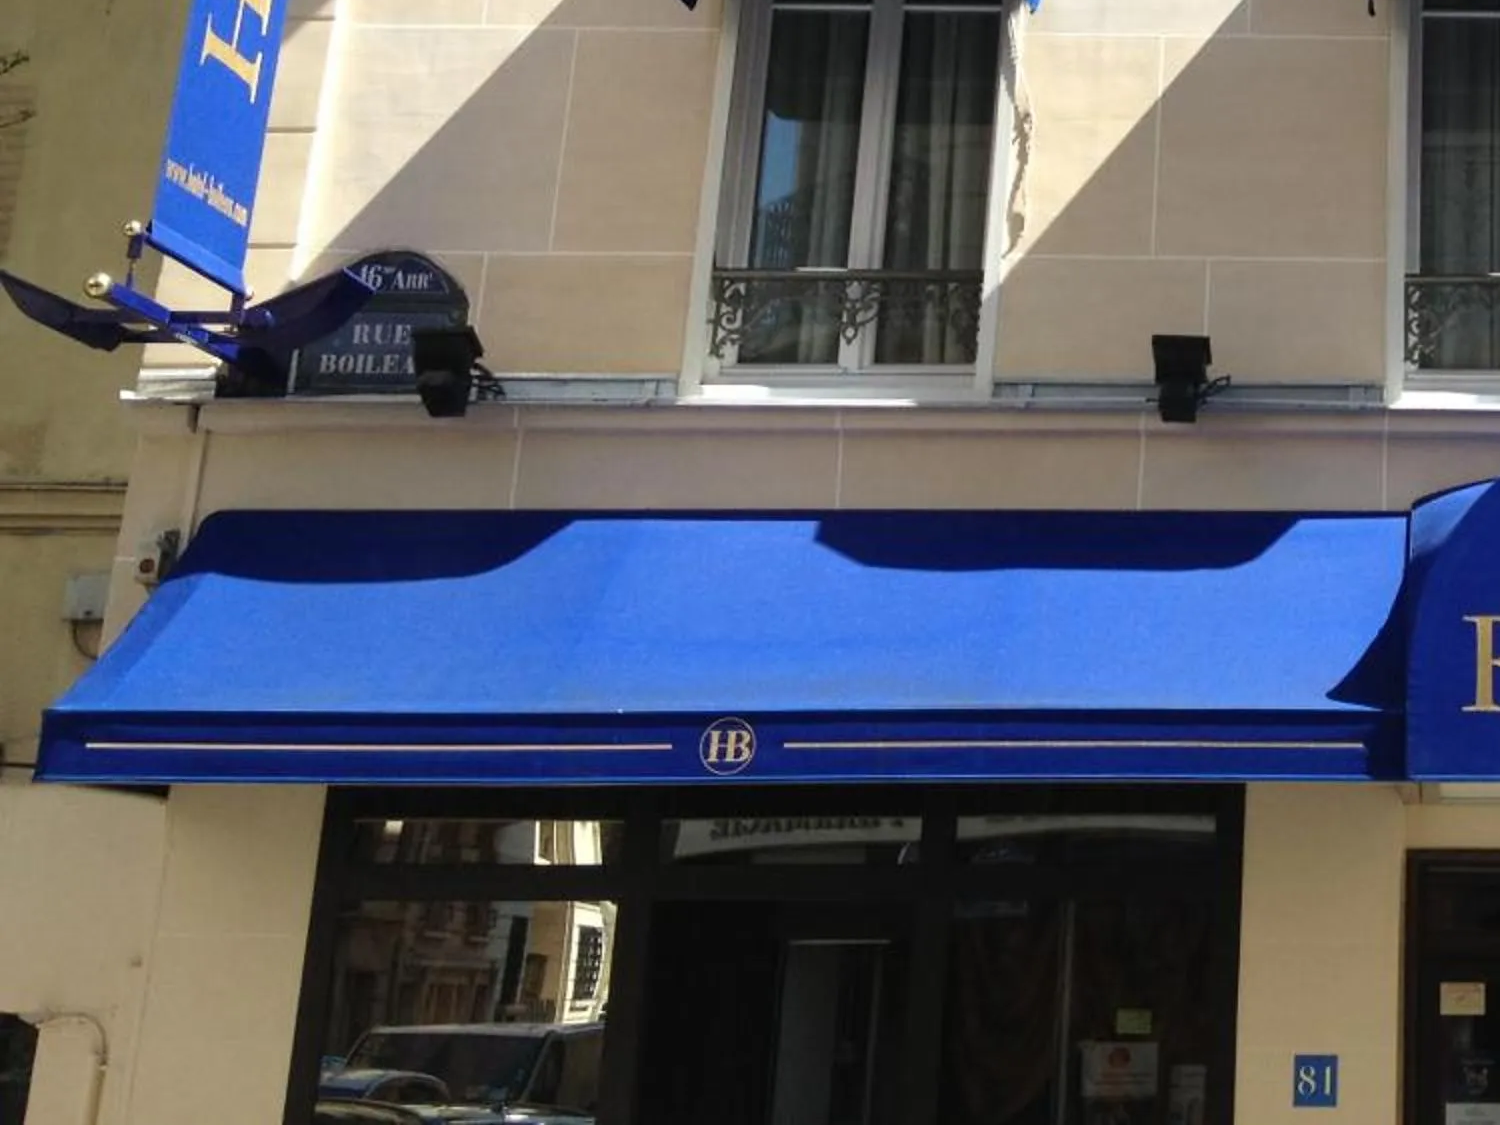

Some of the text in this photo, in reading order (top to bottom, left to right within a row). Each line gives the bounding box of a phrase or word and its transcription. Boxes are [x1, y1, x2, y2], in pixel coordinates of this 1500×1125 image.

[353, 324, 411, 345] RUE
[319, 354, 415, 375] BOILEA
[707, 730, 751, 763] HB
[1297, 1065, 1332, 1096] 81
